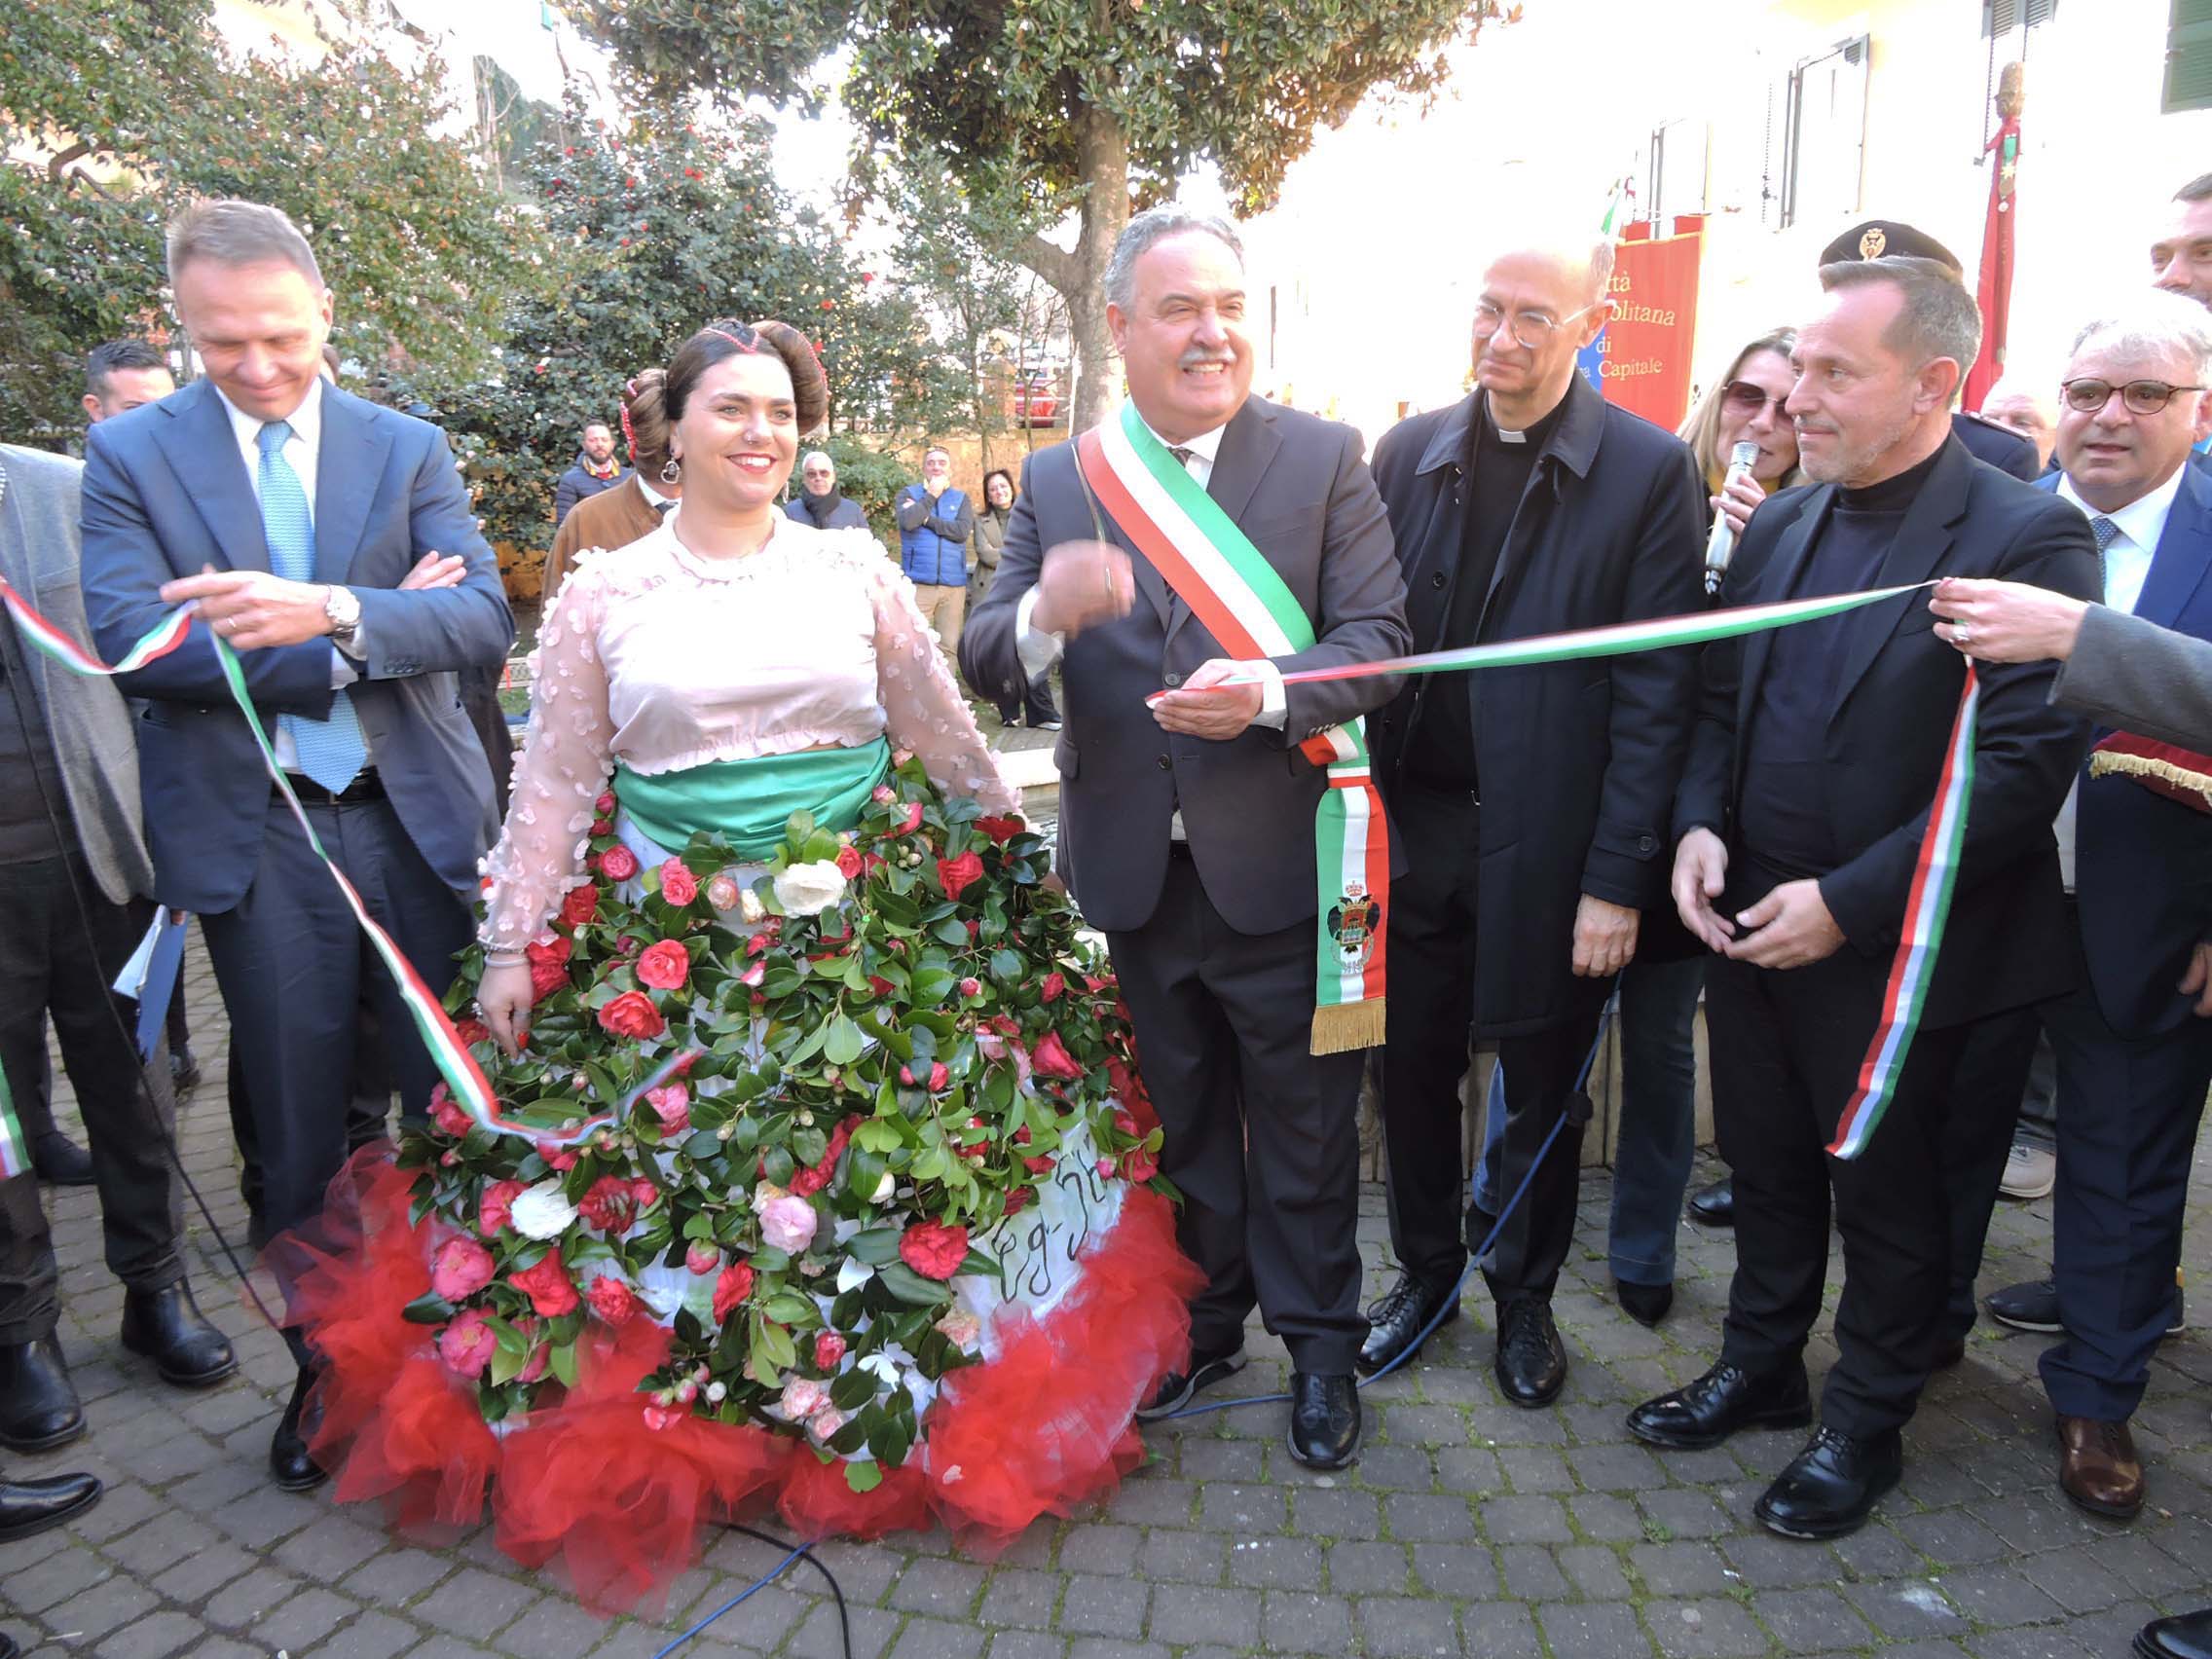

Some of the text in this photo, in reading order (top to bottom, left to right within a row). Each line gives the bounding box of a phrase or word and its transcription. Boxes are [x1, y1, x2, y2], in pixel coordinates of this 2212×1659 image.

[1605, 270, 1632, 293] ttà
[1610, 299, 1676, 327] olitana
[1596, 336, 1612, 353] di
[1598, 357, 1663, 381] Capitale
